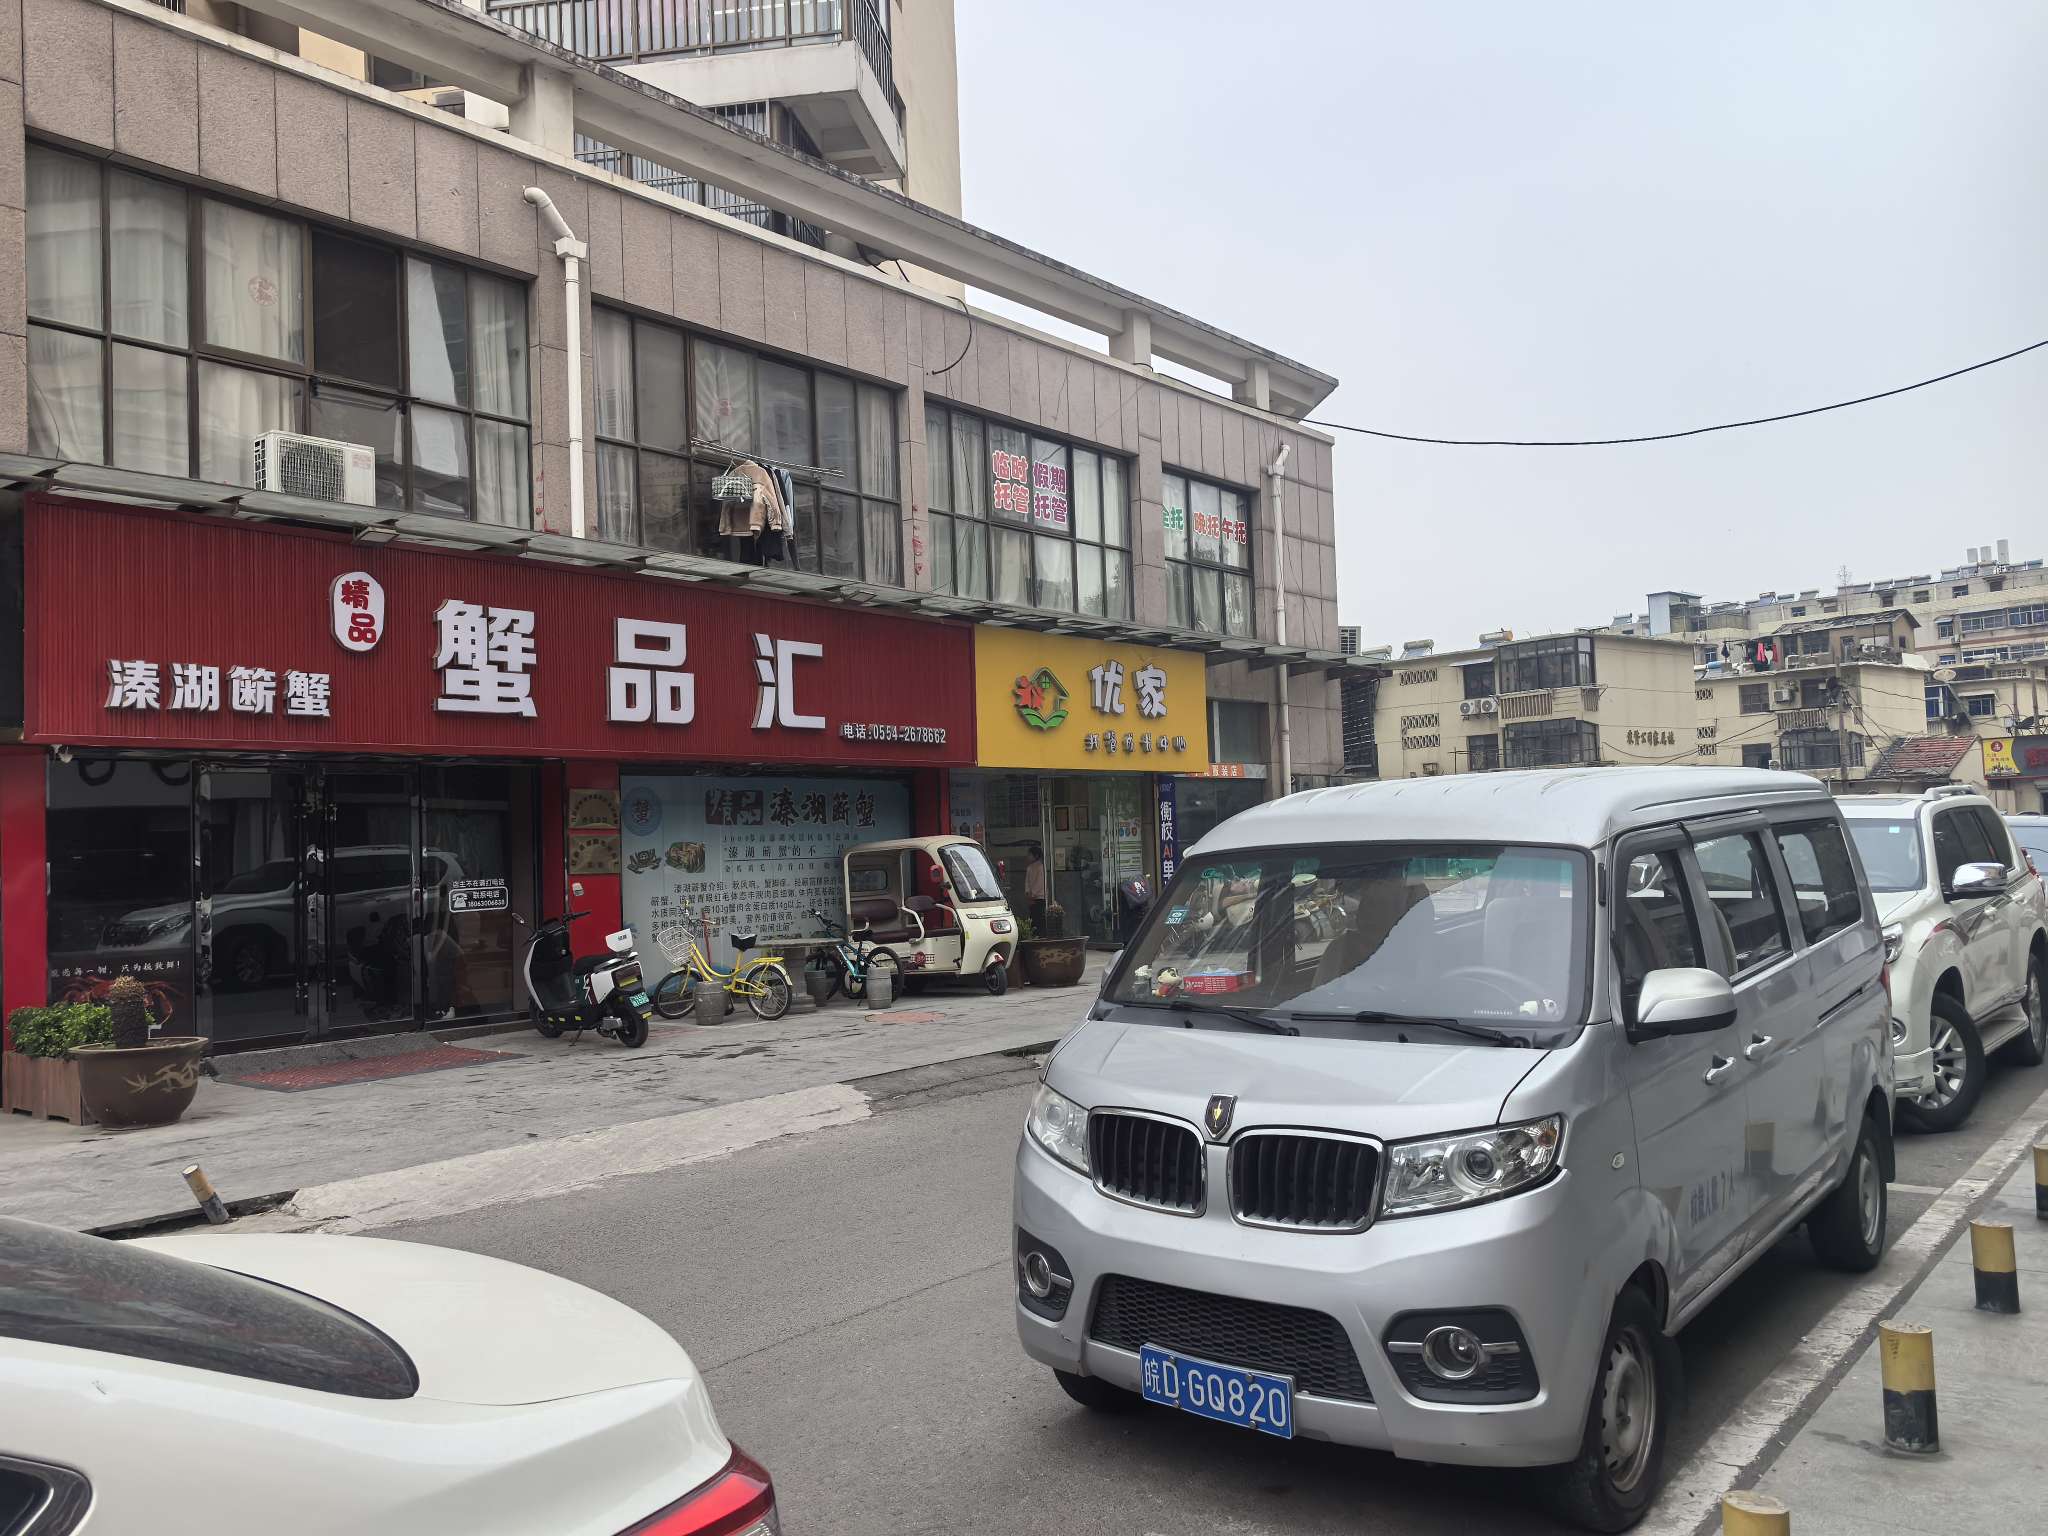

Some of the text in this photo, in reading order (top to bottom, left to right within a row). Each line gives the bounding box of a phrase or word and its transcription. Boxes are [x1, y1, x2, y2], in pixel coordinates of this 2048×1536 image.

[992, 450, 1028, 484] 临时
[1033, 461, 1066, 494] 假期
[994, 480, 1029, 513] 托管
[1034, 492, 1067, 523] 托管
[341, 580, 377, 644] 精品
[434, 600, 826, 729] 蟹品汇
[1089, 659, 1168, 718] 优家
